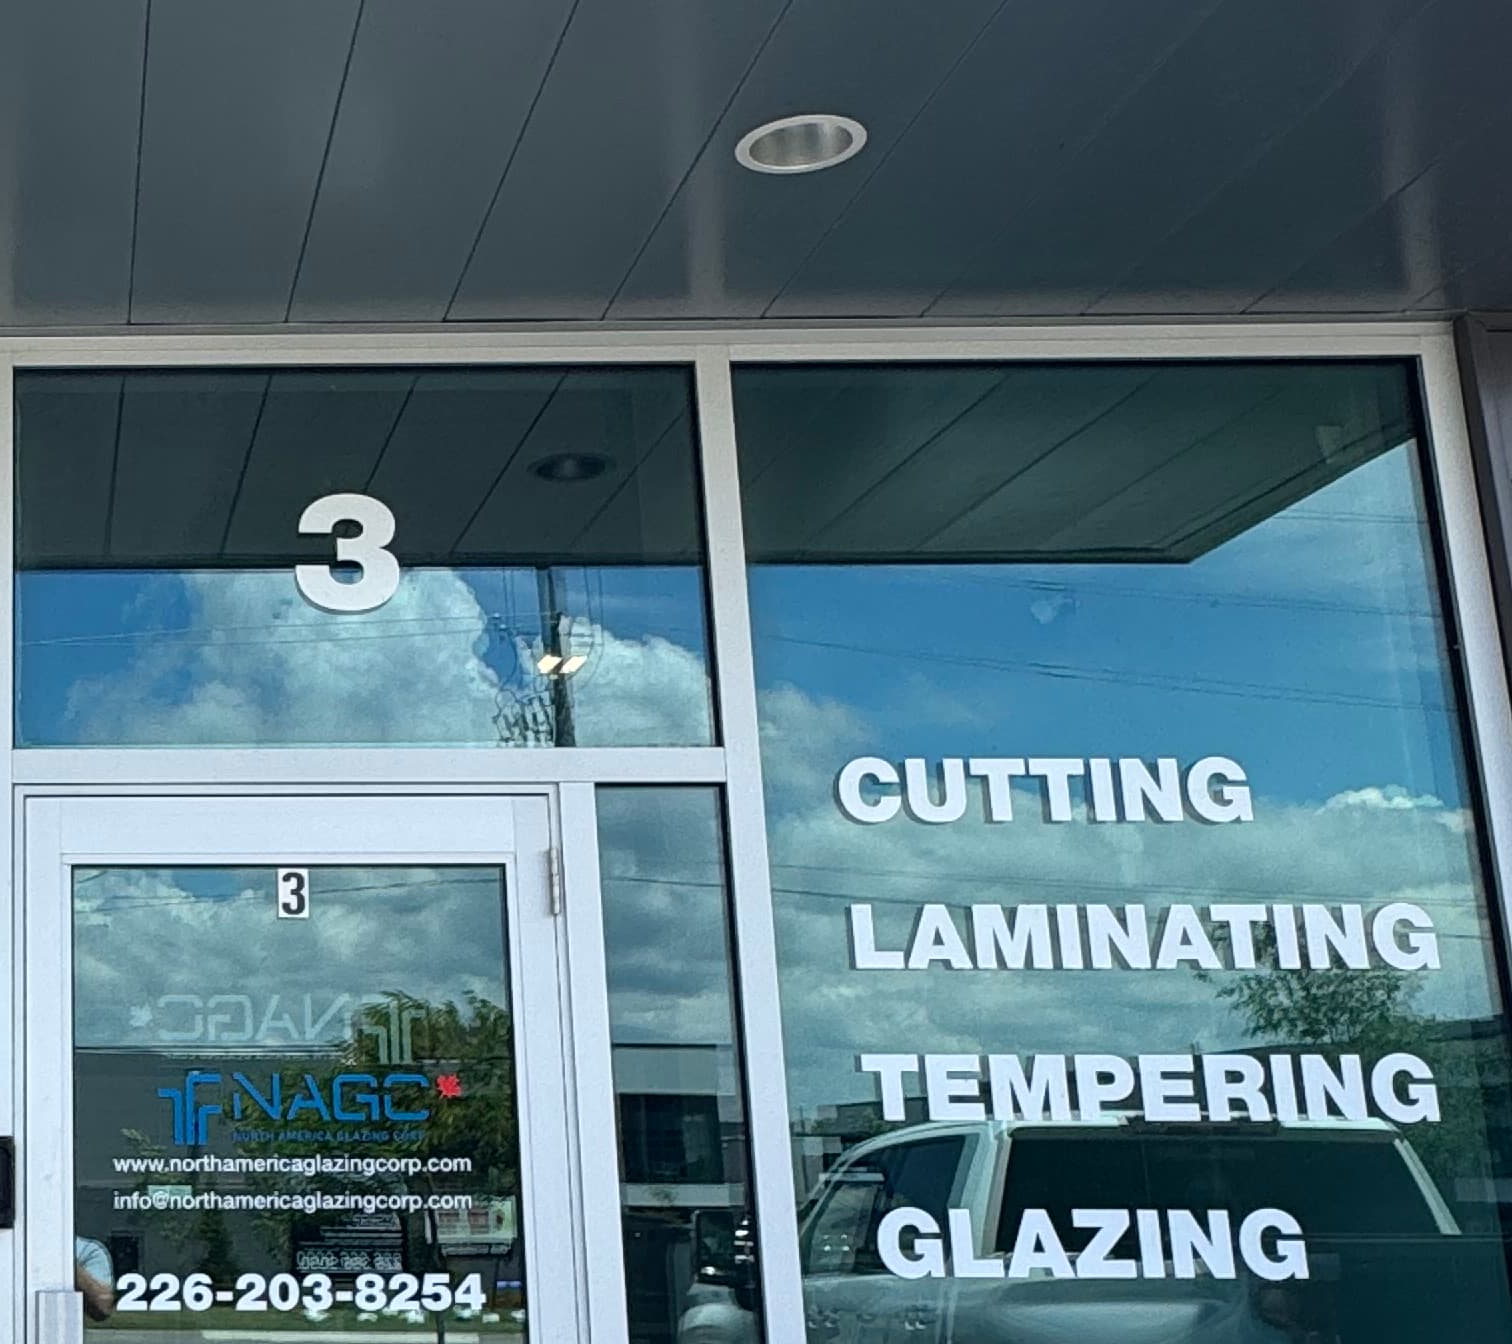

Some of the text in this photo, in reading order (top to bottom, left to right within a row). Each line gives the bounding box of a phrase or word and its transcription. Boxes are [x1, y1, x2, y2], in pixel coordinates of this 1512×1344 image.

[295, 492, 400, 613] 3
[838, 757, 1254, 823] CUTTING
[281, 872, 307, 916] 3
[850, 903, 1442, 970] LAMINATING
[232, 1072, 431, 1122] NAGC
[861, 1054, 1441, 1123] TEMPERING
[278, 1130, 335, 1142] AMERICA
[113, 1154, 472, 1176] www.northamericaglazingcorp.com
[113, 1190, 473, 1214] info@northamericaglazingcorp.com
[877, 1208, 1310, 1280] GLAZING
[116, 1272, 487, 1312] 226-203-8254
